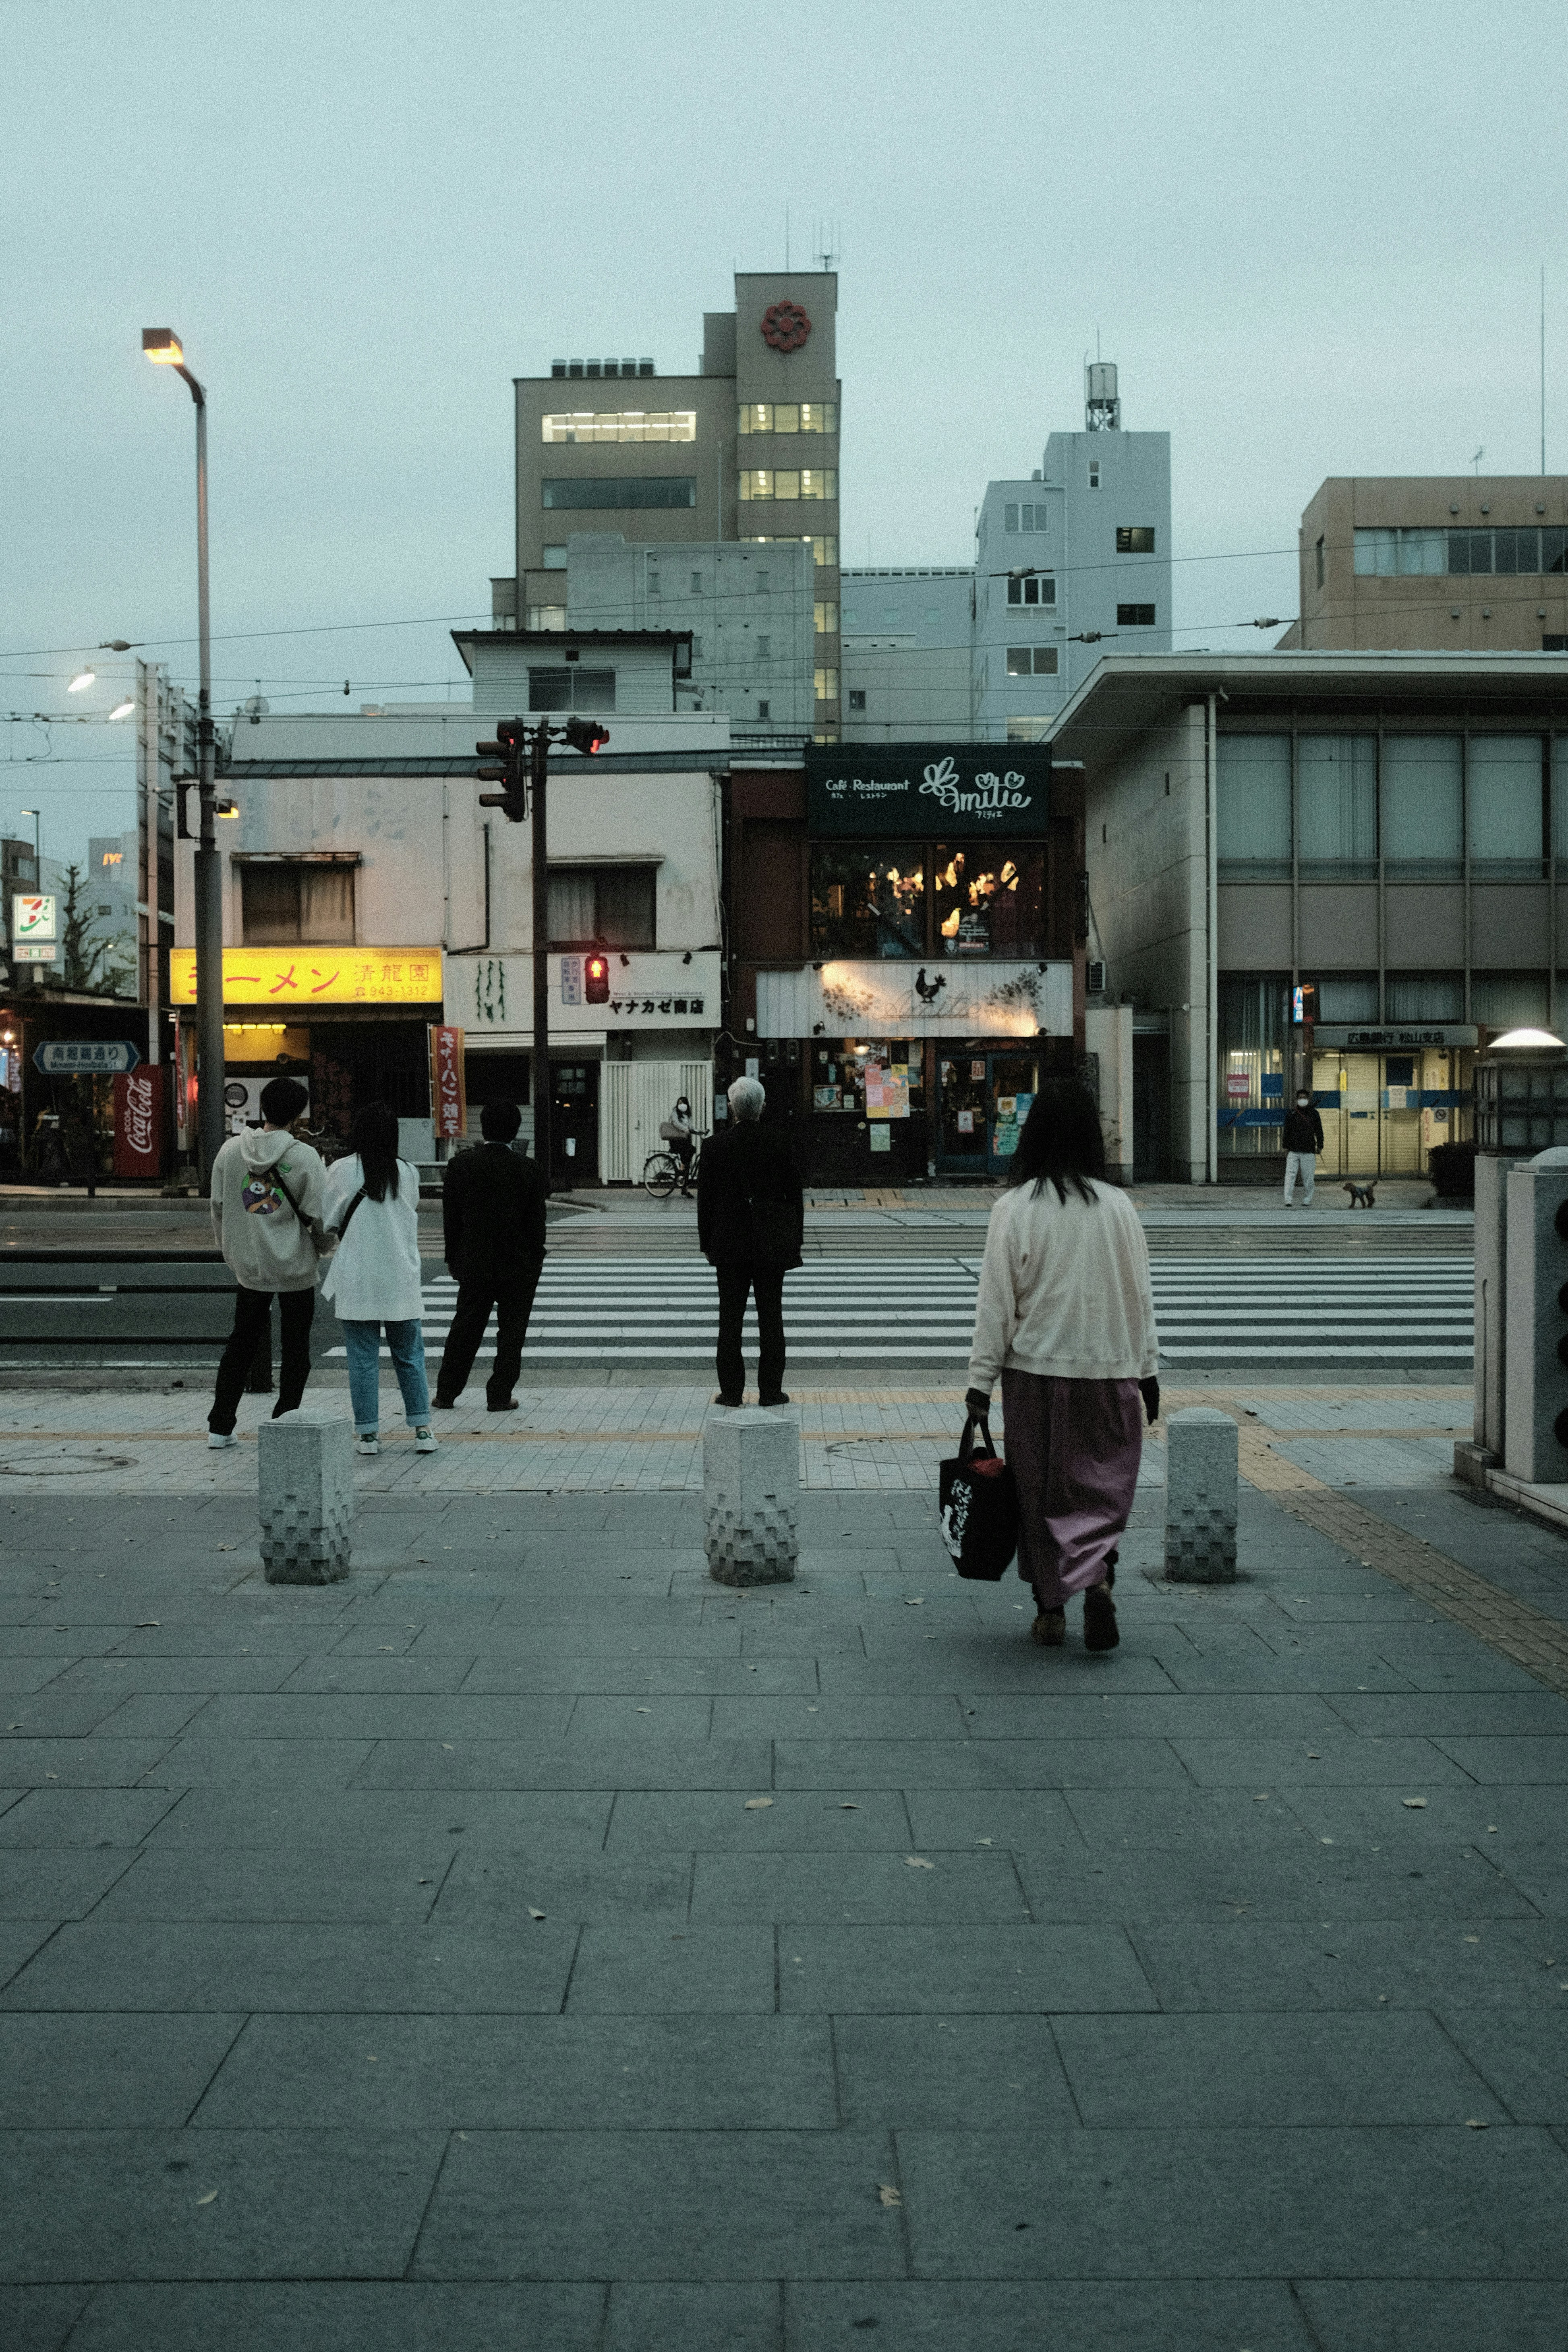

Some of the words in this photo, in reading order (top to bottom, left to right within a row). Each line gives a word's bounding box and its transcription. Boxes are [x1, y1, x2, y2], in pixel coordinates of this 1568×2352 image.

[825, 779, 847, 791] Café
[853, 779, 910, 791] Restaurant
[975, 810, 1003, 819] アミティエ
[354, 964, 429, 982] 清龍園
[371, 986, 427, 996] 943-1312
[609, 999, 704, 1014] ヤナカゼ商店
[1348, 1032, 1394, 1044] 広島銀行
[1399, 1032, 1444, 1044] 松山支店
